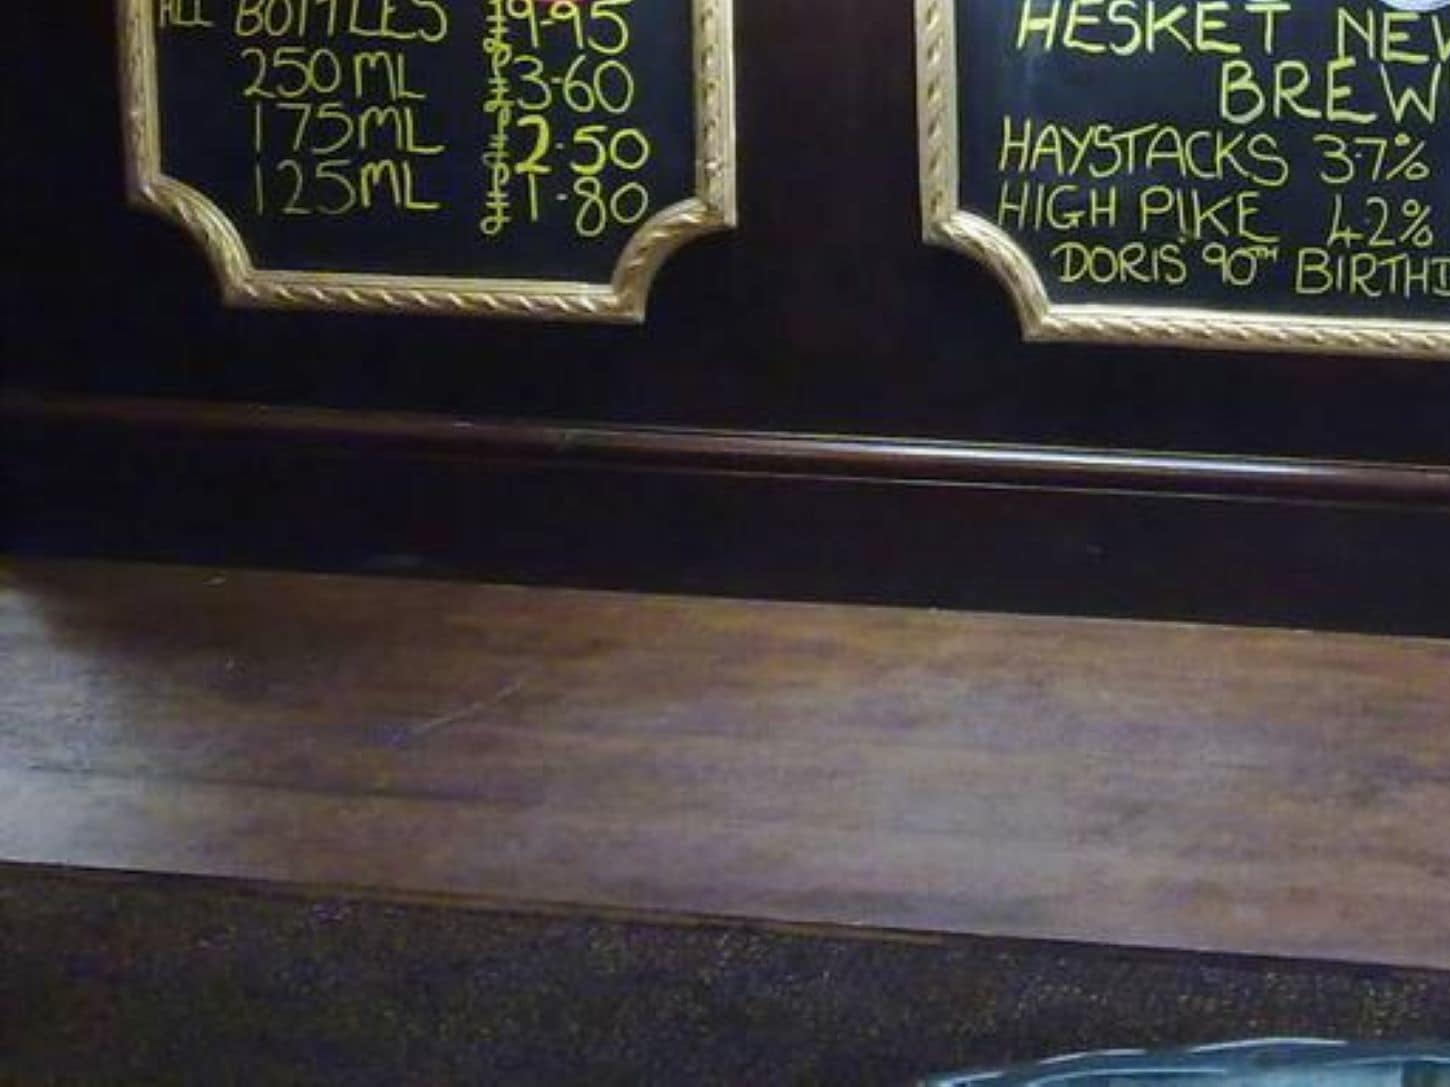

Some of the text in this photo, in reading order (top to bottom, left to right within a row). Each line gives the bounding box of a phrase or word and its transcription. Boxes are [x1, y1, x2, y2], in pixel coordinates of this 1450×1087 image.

[998, 115, 1290, 188] HAYSTACKS
[999, 179, 1117, 232] HIGH
[1139, 184, 1281, 242] PIKE
